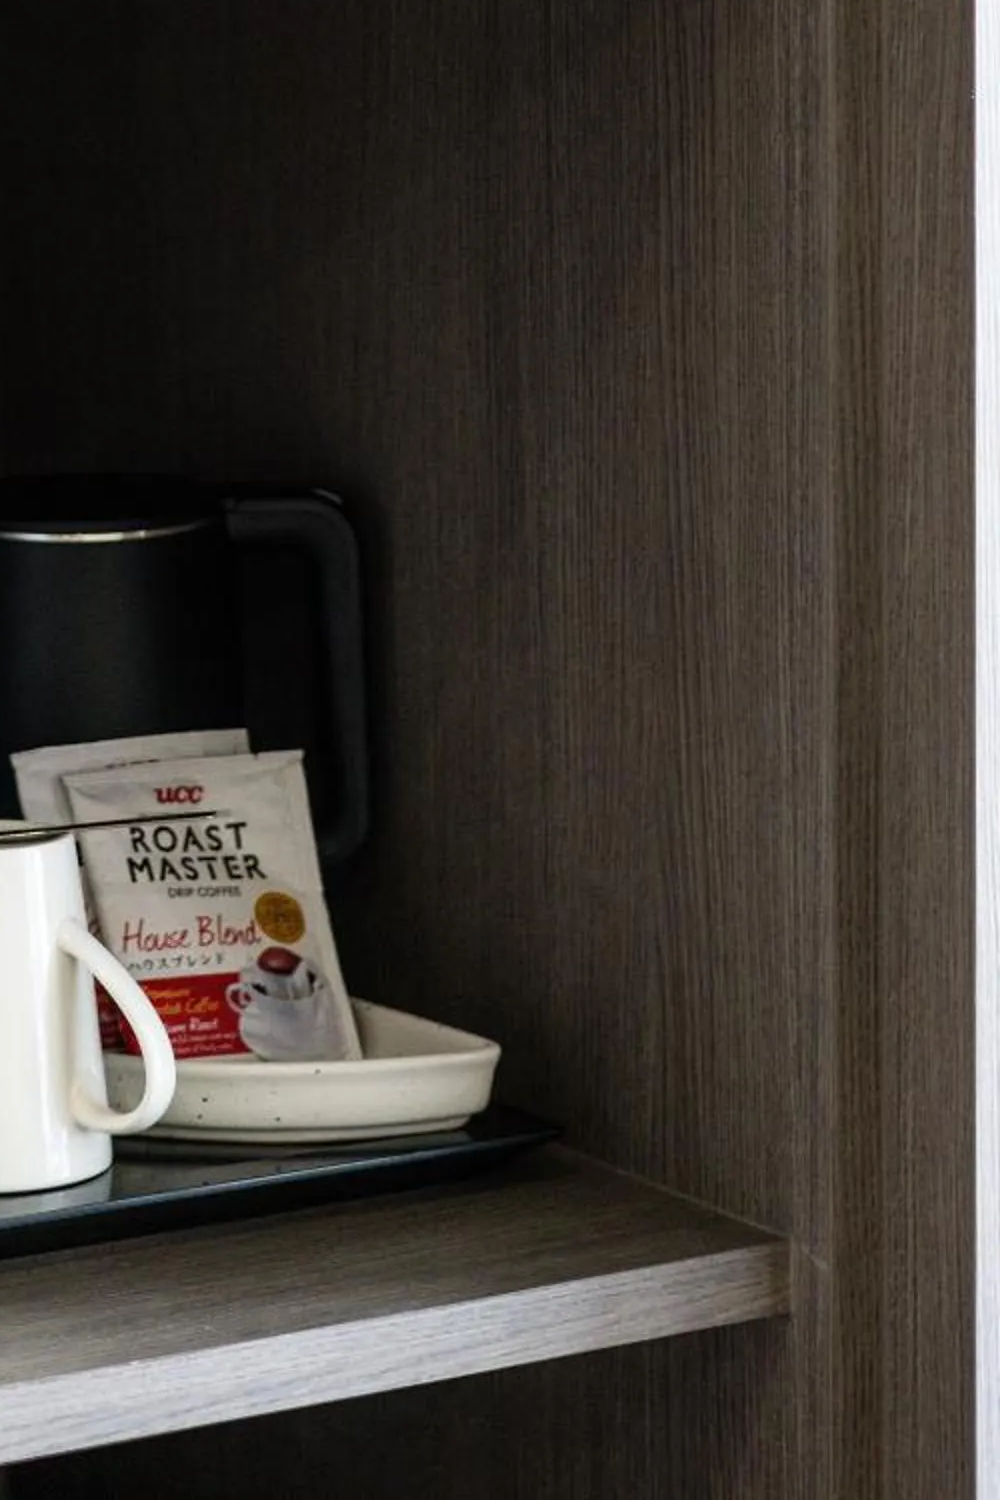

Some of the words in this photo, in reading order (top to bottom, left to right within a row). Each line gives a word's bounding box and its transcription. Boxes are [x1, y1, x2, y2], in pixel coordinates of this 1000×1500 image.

[129, 822, 248, 854] ROAST
[126, 853, 268, 884] MASTER
[167, 886, 194, 899] DRIP
[197, 886, 242, 898] COFFEE
[122, 918, 192, 954] House
[195, 913, 262, 947] Blend
